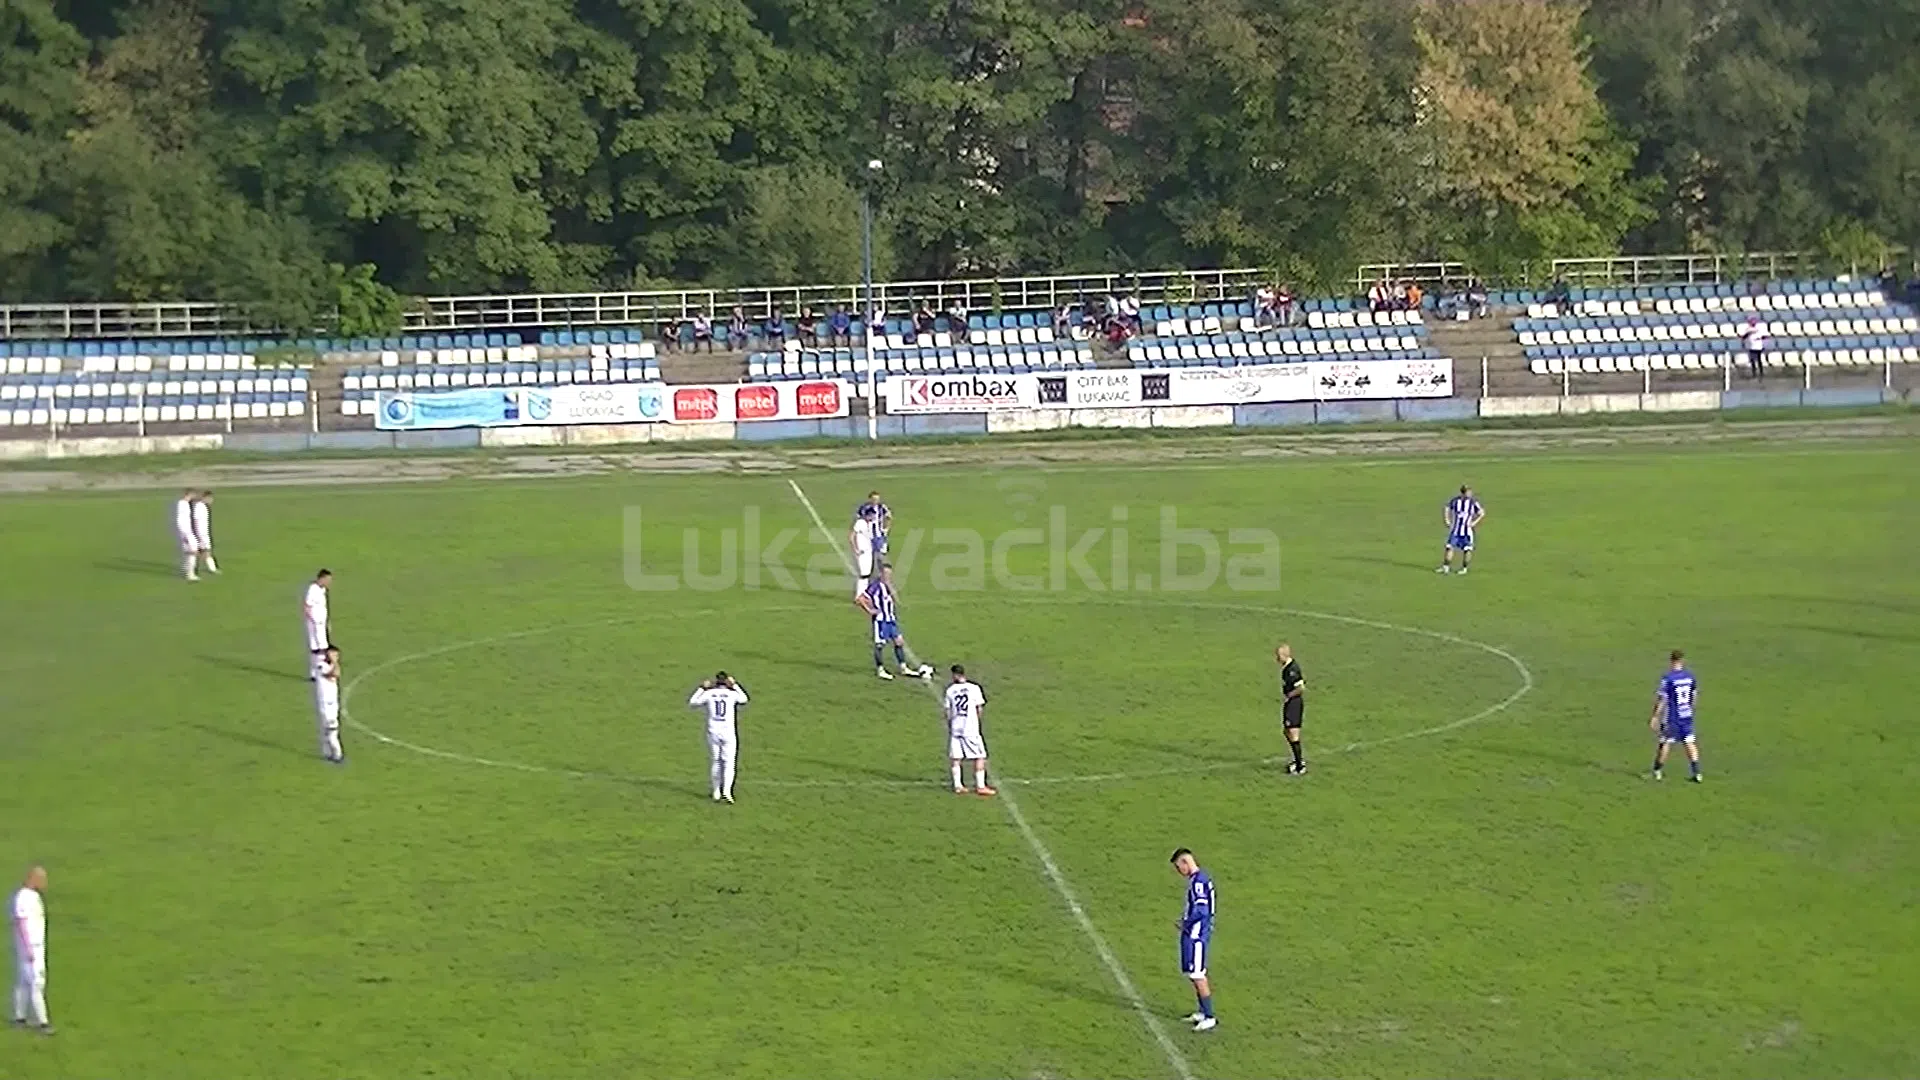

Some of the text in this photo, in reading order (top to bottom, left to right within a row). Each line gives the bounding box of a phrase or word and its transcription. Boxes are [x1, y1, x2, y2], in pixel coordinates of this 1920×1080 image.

[1077, 374, 1129, 388] CITY BAR
[902, 376, 1018, 406] Kombax
[1077, 390, 1131, 404] LUKAVAC
[714, 699, 727, 717] 10
[954, 694, 969, 711] 22
